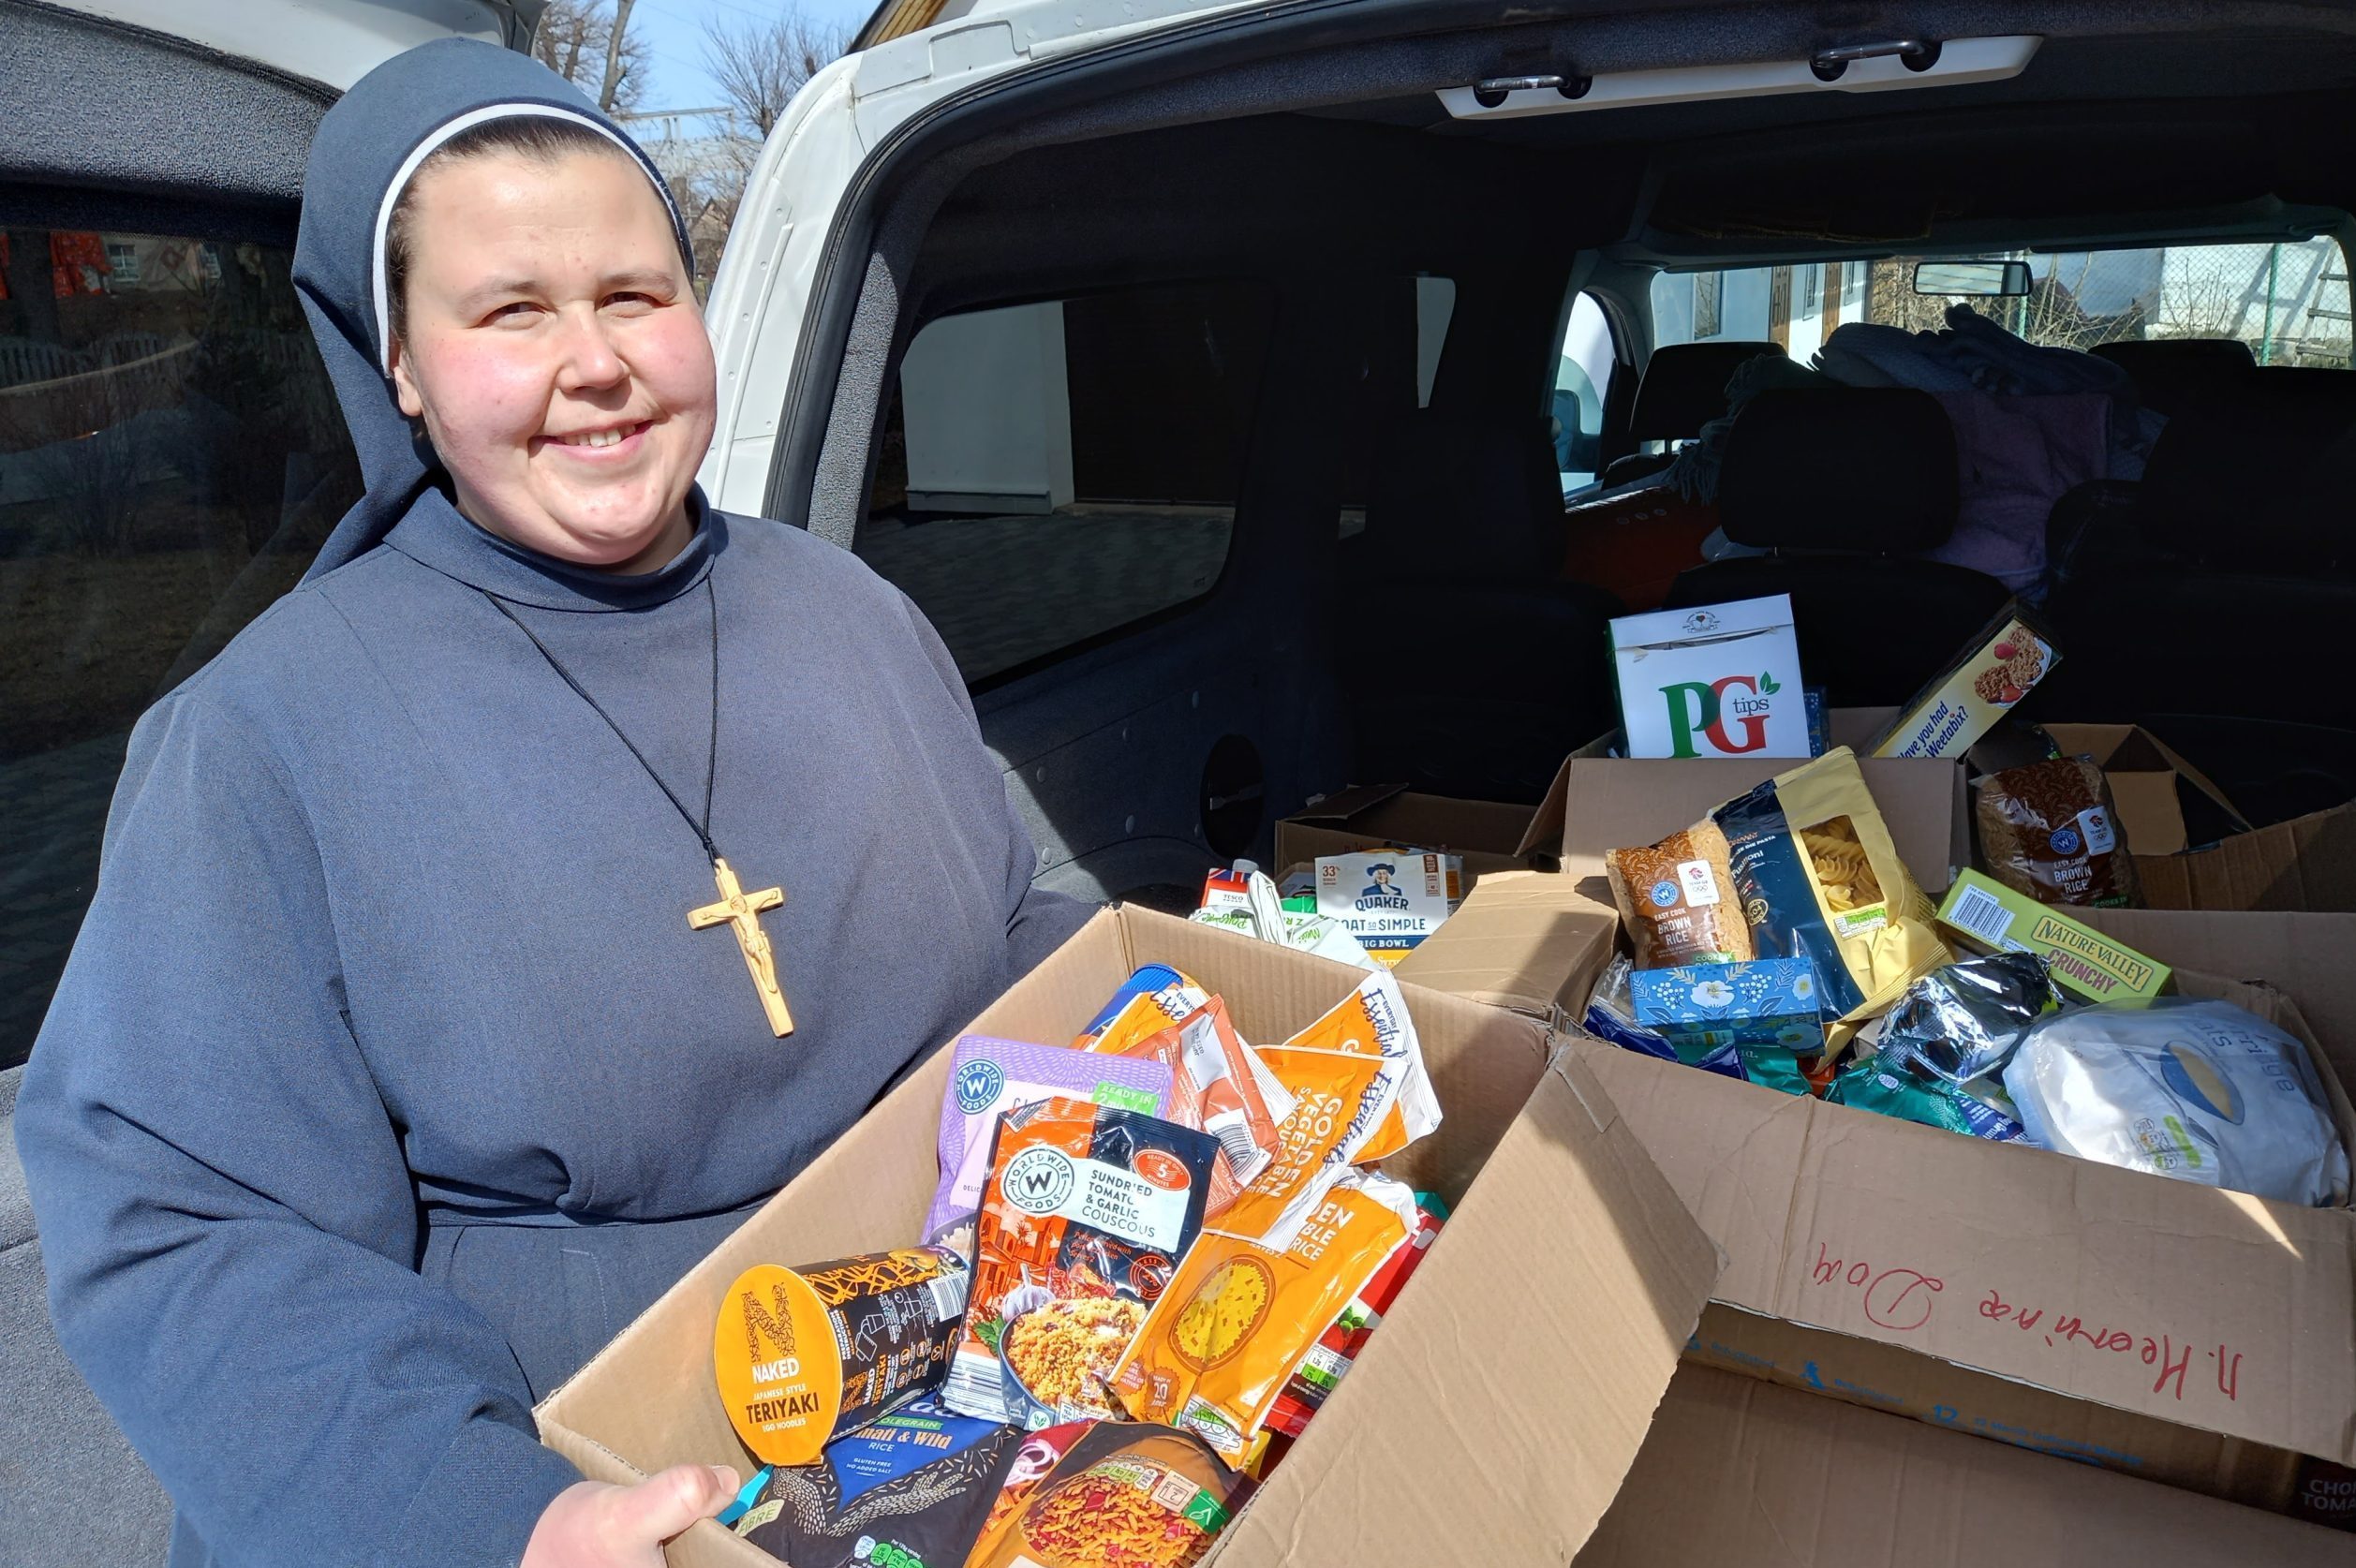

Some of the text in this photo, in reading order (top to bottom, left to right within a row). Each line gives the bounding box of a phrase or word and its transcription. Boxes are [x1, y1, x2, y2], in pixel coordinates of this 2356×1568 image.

[1658, 675, 1770, 758] PG
[1733, 696, 1770, 717] tips
[1918, 722, 1934, 747] you
[1930, 701, 1949, 728] had
[1925, 705, 1968, 758] Weetabix?
[1756, 835, 1776, 845] PASTA
[2053, 855, 2088, 869] EASY COOK
[2053, 865, 2092, 882] BROWN
[2064, 879, 2089, 894] RICE
[1222, 894, 1244, 902] TESCO
[1356, 896, 1409, 911] QUAKER
[1378, 918, 1426, 931] SIMPLE
[1654, 907, 1686, 922] EASY COOK
[1657, 916, 1692, 935] BROWN
[1378, 939, 1409, 948] BOWL
[1666, 931, 1689, 946] RICE
[2038, 920, 2095, 956] NATURE
[2097, 949, 2150, 985] VALLEY
[2047, 949, 2119, 995] CRUNCHY
[1360, 988, 1408, 1058] Essential
[1382, 1000, 1398, 1028] EVERYDAY
[956, 1064, 1000, 1092] WORLDWIDE
[966, 1076, 986, 1097] W
[961, 1094, 993, 1110] FOODS
[1099, 1094, 1107, 1105] 2
[1101, 1085, 1153, 1103] READY IN
[1322, 1071, 1392, 1169] Essentials
[1257, 1093, 1329, 1193] VEGETABLE
[1267, 1098, 1343, 1198] GOLDEN
[1008, 1153, 1070, 1188] WORLDWIDE
[1147, 1154, 1164, 1163] READY
[1171, 1162, 1185, 1176] ONLY
[1157, 1163, 1168, 1177] 5
[1025, 1171, 1053, 1194] W
[1146, 1173, 1170, 1188] MINUTES
[1016, 1192, 1060, 1209] FOODS
[1086, 1193, 1140, 1220] & GARLIC
[1082, 1206, 1155, 1238] COUSCOUS
[741, 1281, 796, 1364] N
[829, 1310, 847, 1361] PREPARATION
[834, 1309, 852, 1360] INSTRUCTIONS
[751, 1358, 800, 1384] NAKED
[871, 1354, 887, 1407] TERIYAKI
[753, 1383, 807, 1401] JAPANESE STYLE
[864, 1368, 875, 1404] NAKED
[1153, 1383, 1169, 1400] 20
[746, 1392, 820, 1425] TERIYAKI
[777, 1418, 807, 1430] NOODLES
[853, 1427, 953, 1450] mati & Wild
[868, 1442, 896, 1452] RICE
[853, 1457, 875, 1466] GLUTEN
[856, 1464, 876, 1472] ADDED
[739, 1508, 775, 1531] FIBRE
